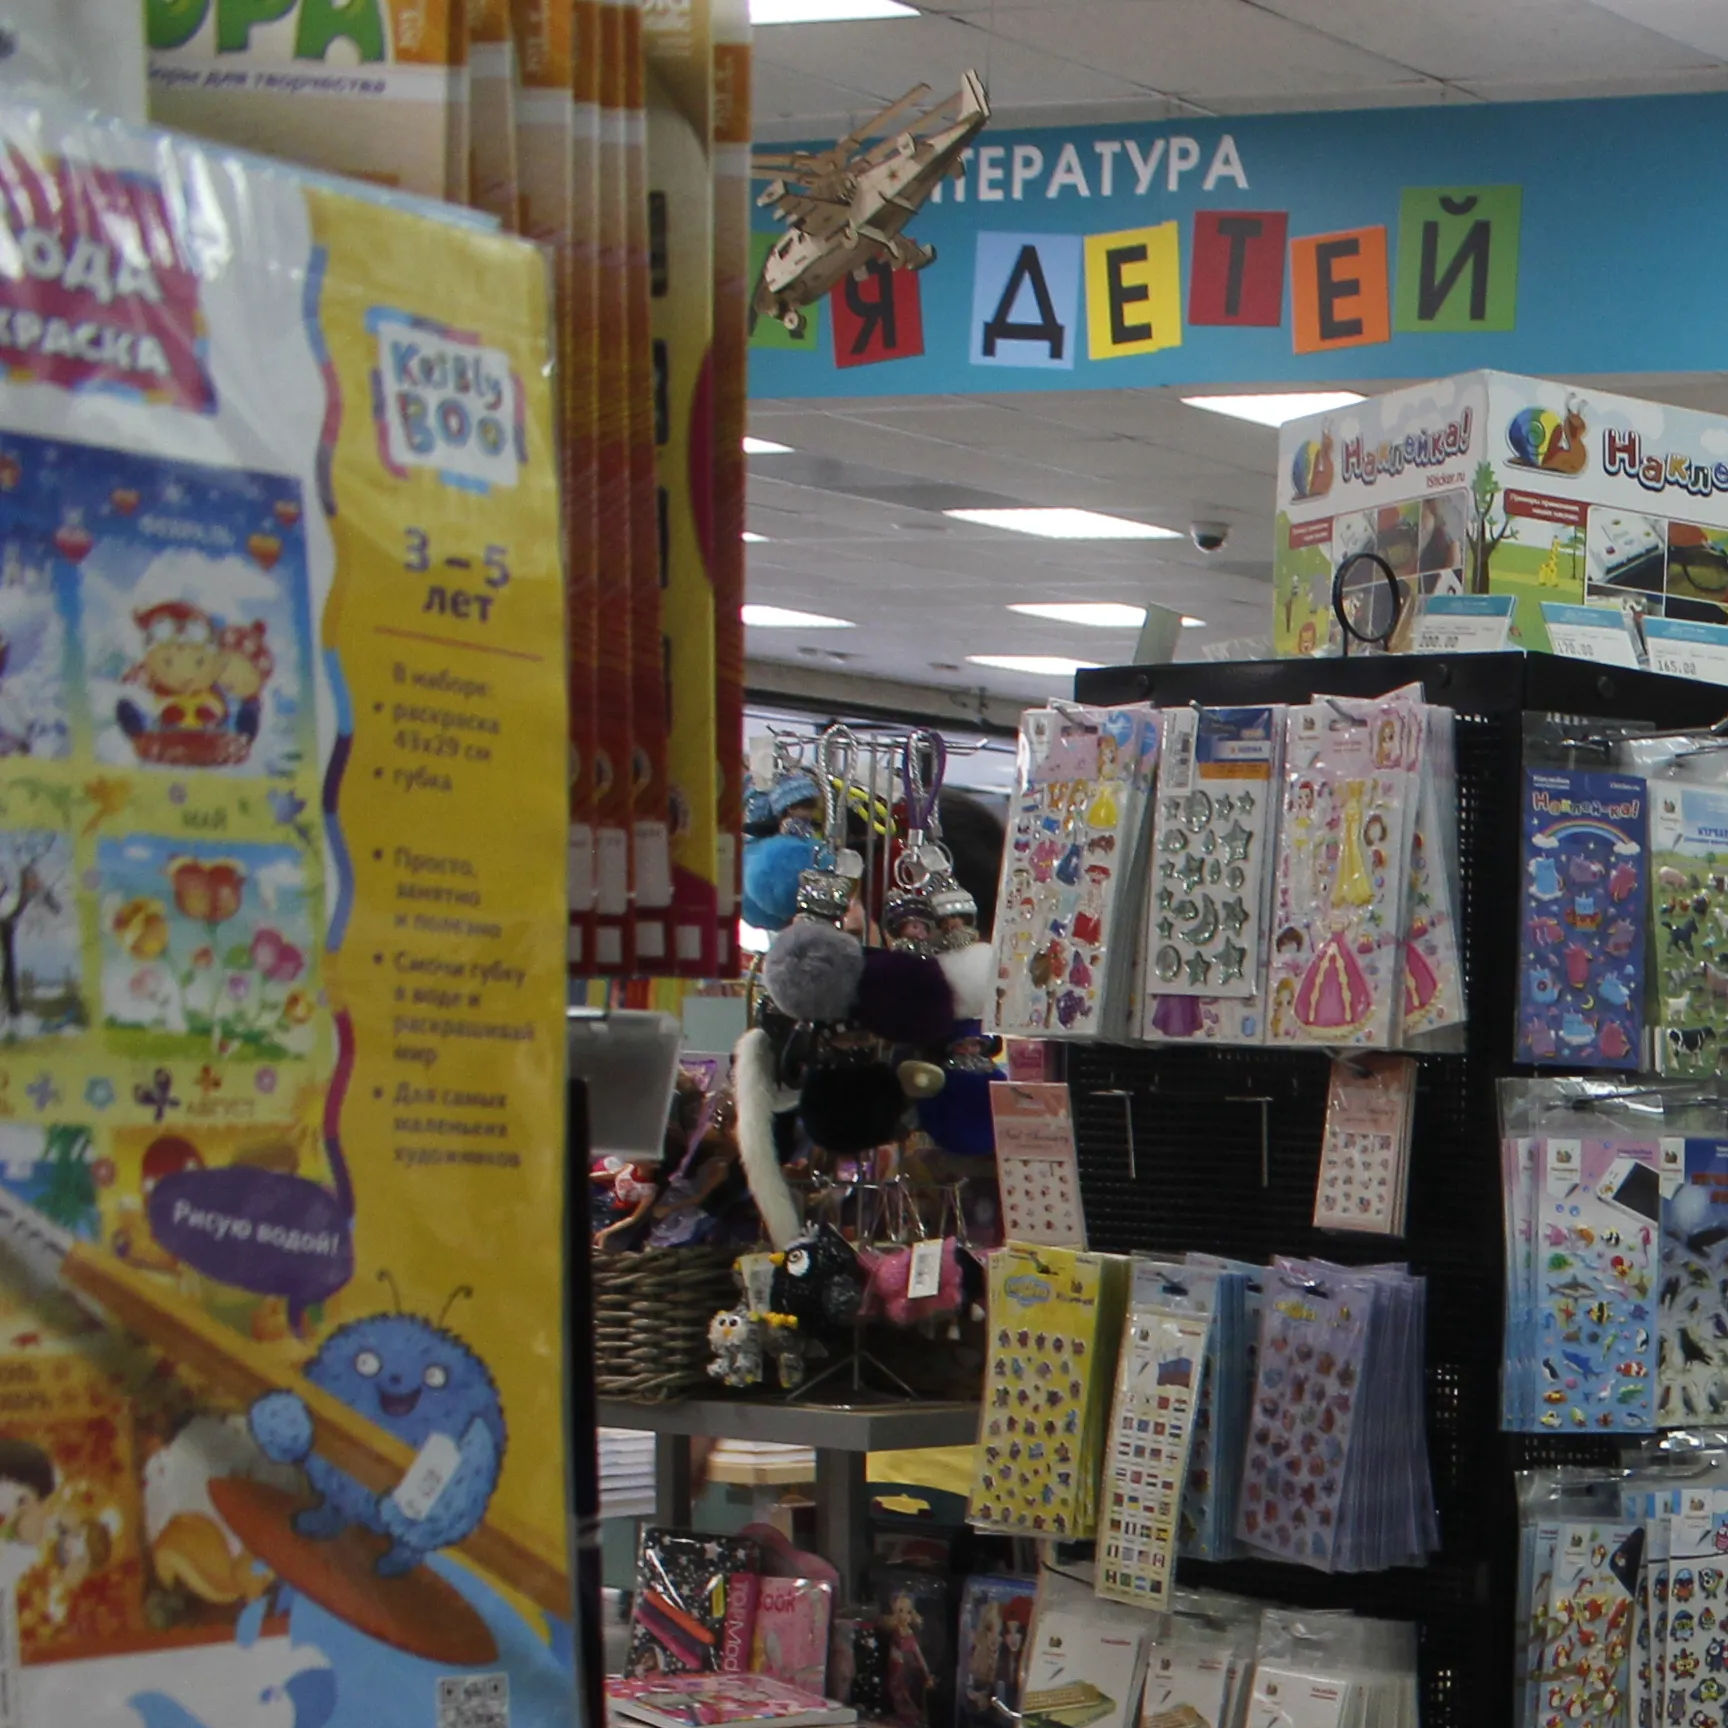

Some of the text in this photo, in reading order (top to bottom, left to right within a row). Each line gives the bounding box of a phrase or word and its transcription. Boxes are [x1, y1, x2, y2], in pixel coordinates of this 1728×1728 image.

[981, 196, 1491, 361] ДЕТЕЙ
[405, 526, 431, 573] 3
[483, 544, 512, 591] 5
[420, 584, 496, 623] лет
[173, 1199, 341, 1260] Рисую водой!
